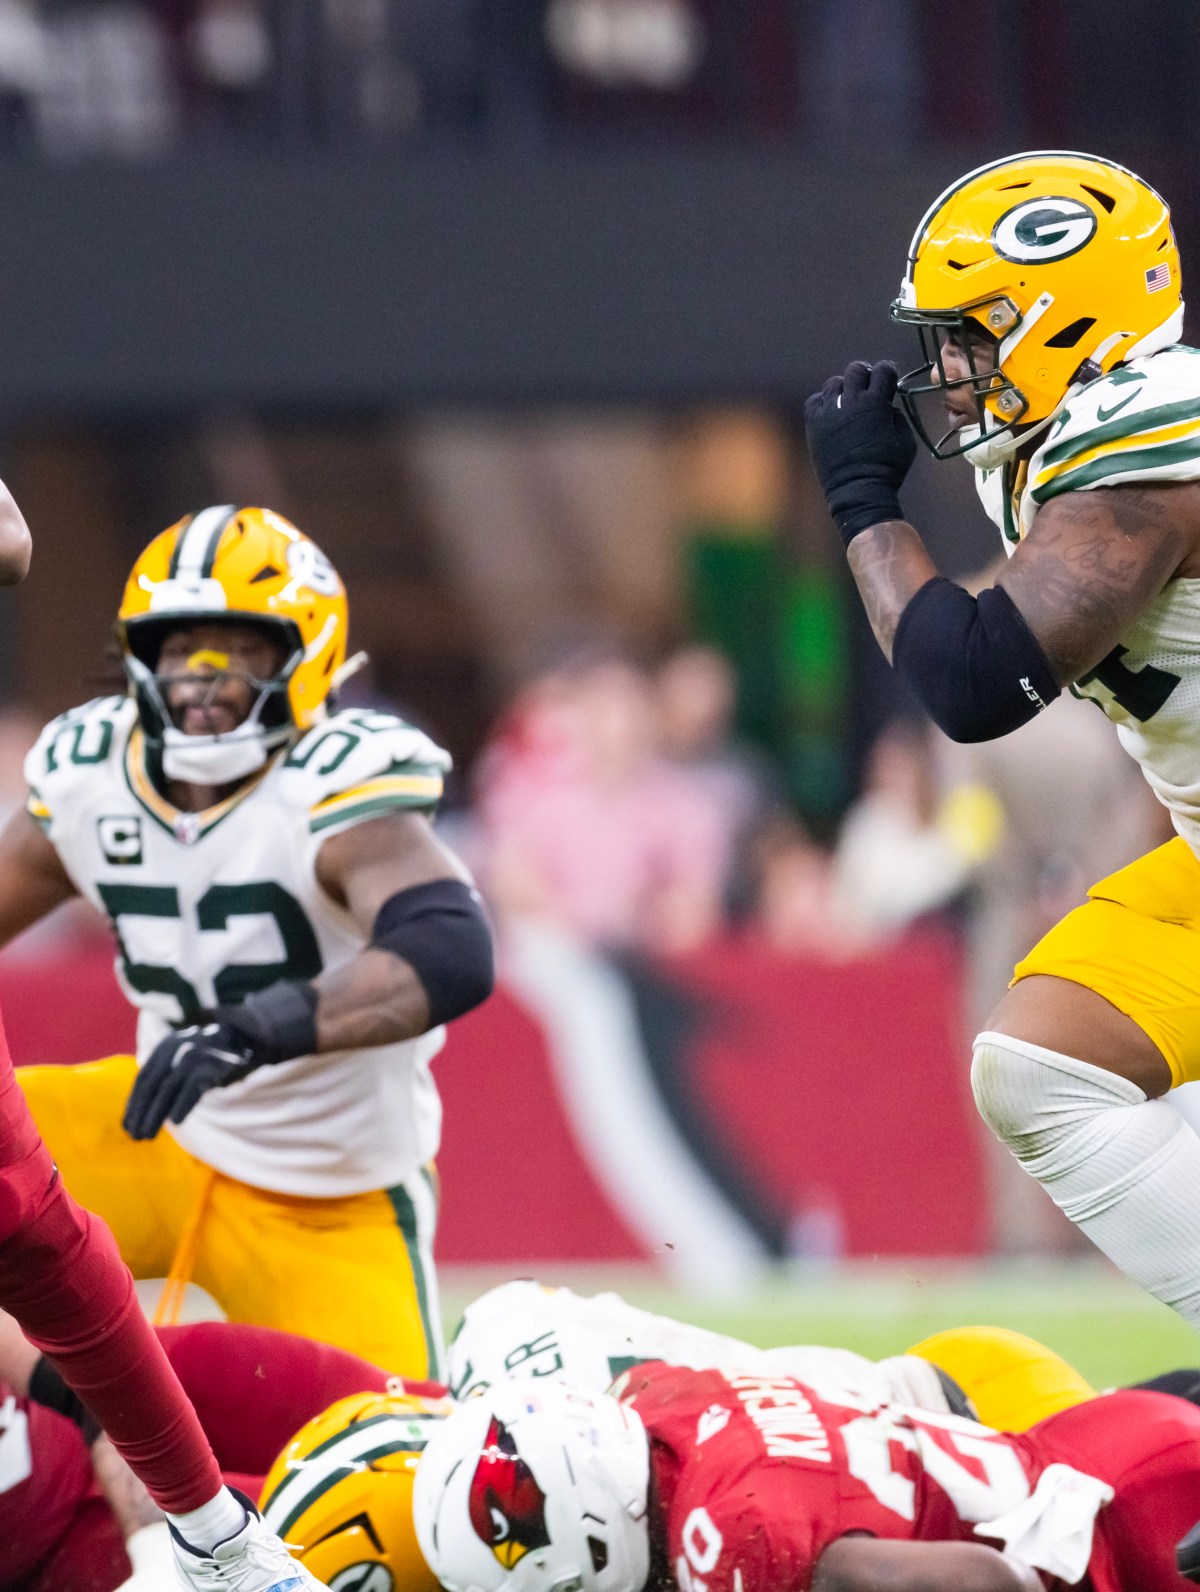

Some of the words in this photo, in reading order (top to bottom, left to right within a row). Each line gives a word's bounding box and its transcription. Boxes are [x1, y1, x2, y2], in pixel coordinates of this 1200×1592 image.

[995, 198, 1094, 261] G
[100, 817, 142, 858] C
[96, 881, 324, 1028] 52
